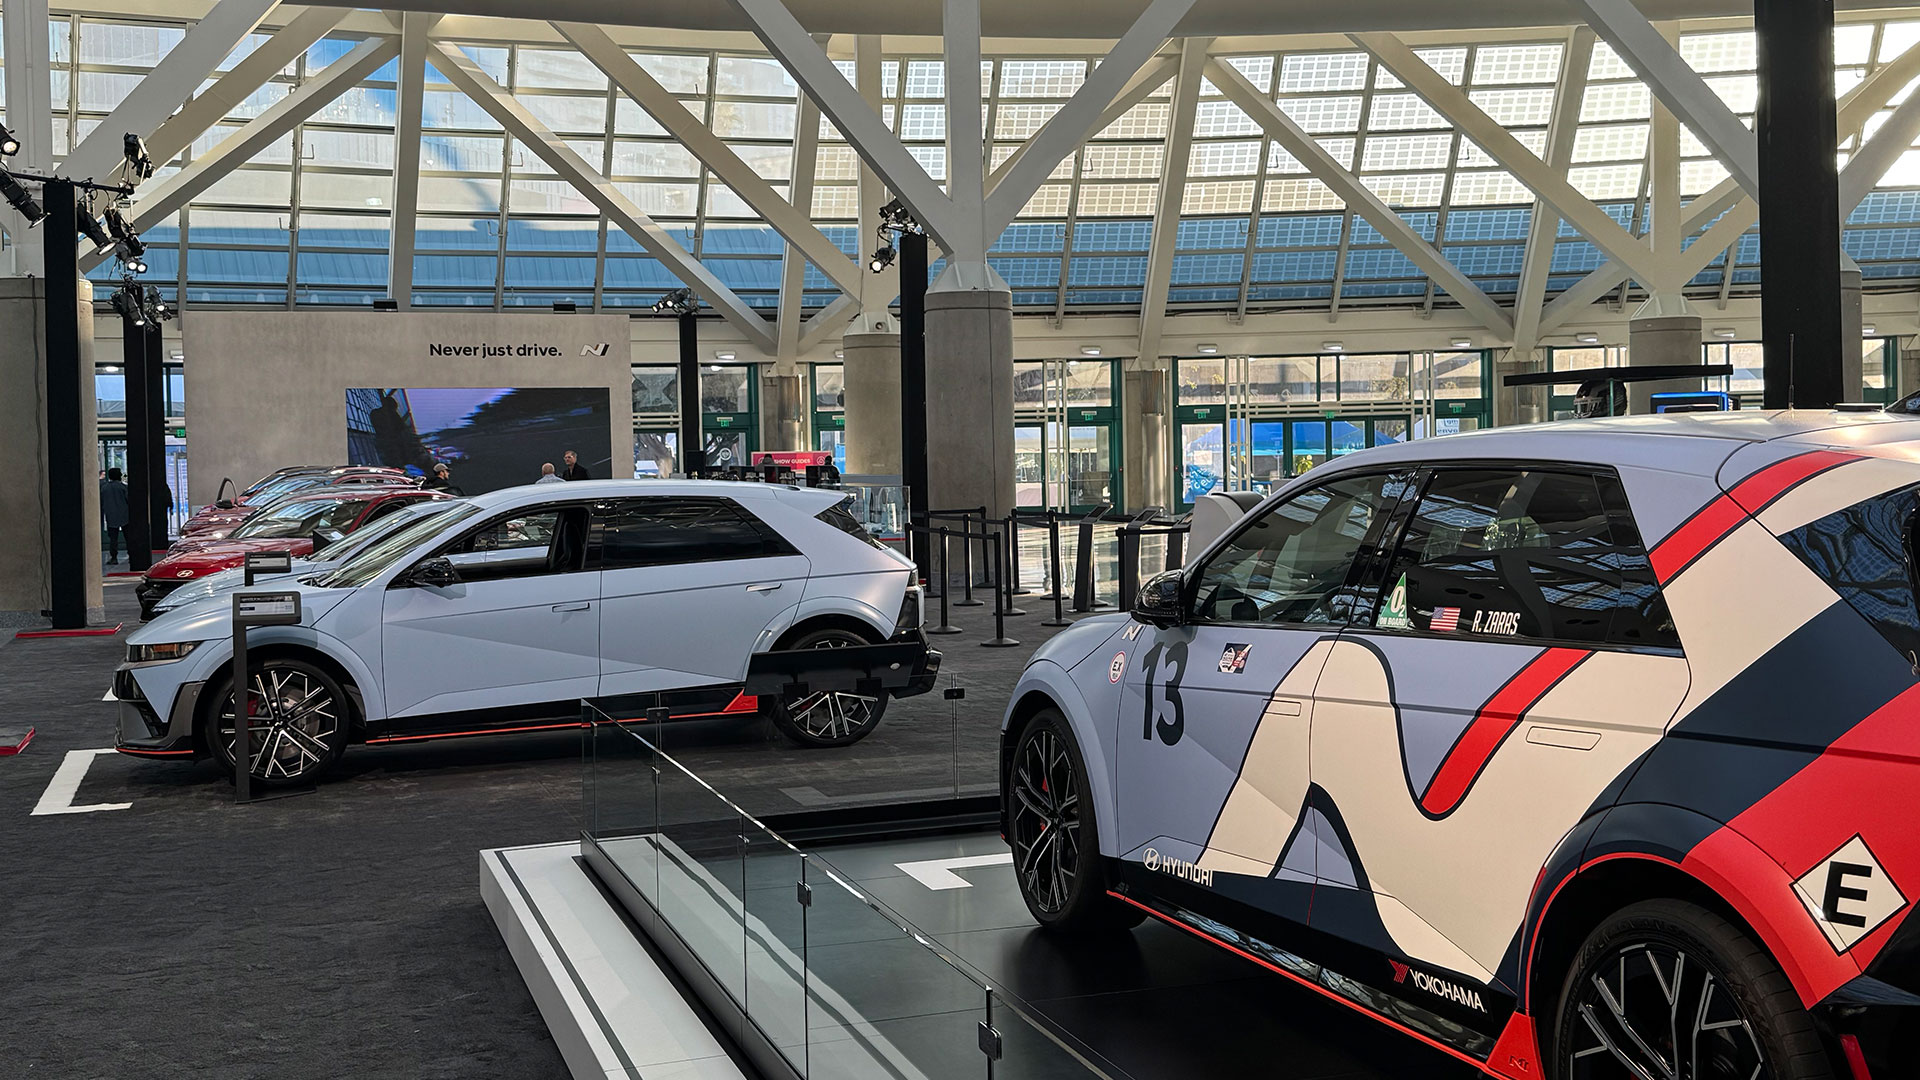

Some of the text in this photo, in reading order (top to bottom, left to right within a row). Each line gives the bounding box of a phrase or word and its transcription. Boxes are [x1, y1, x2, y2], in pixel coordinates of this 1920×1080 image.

[430, 344, 479, 356] Never
[482, 344, 513, 359] just
[516, 344, 562, 356] drive.
[1471, 610, 1520, 636] R. ZARAS
[1142, 641, 1189, 746] 13
[1163, 855, 1213, 887] HYUNDAI
[1821, 860, 1873, 928] E
[1409, 968, 1485, 1013] YOKOHAMA
